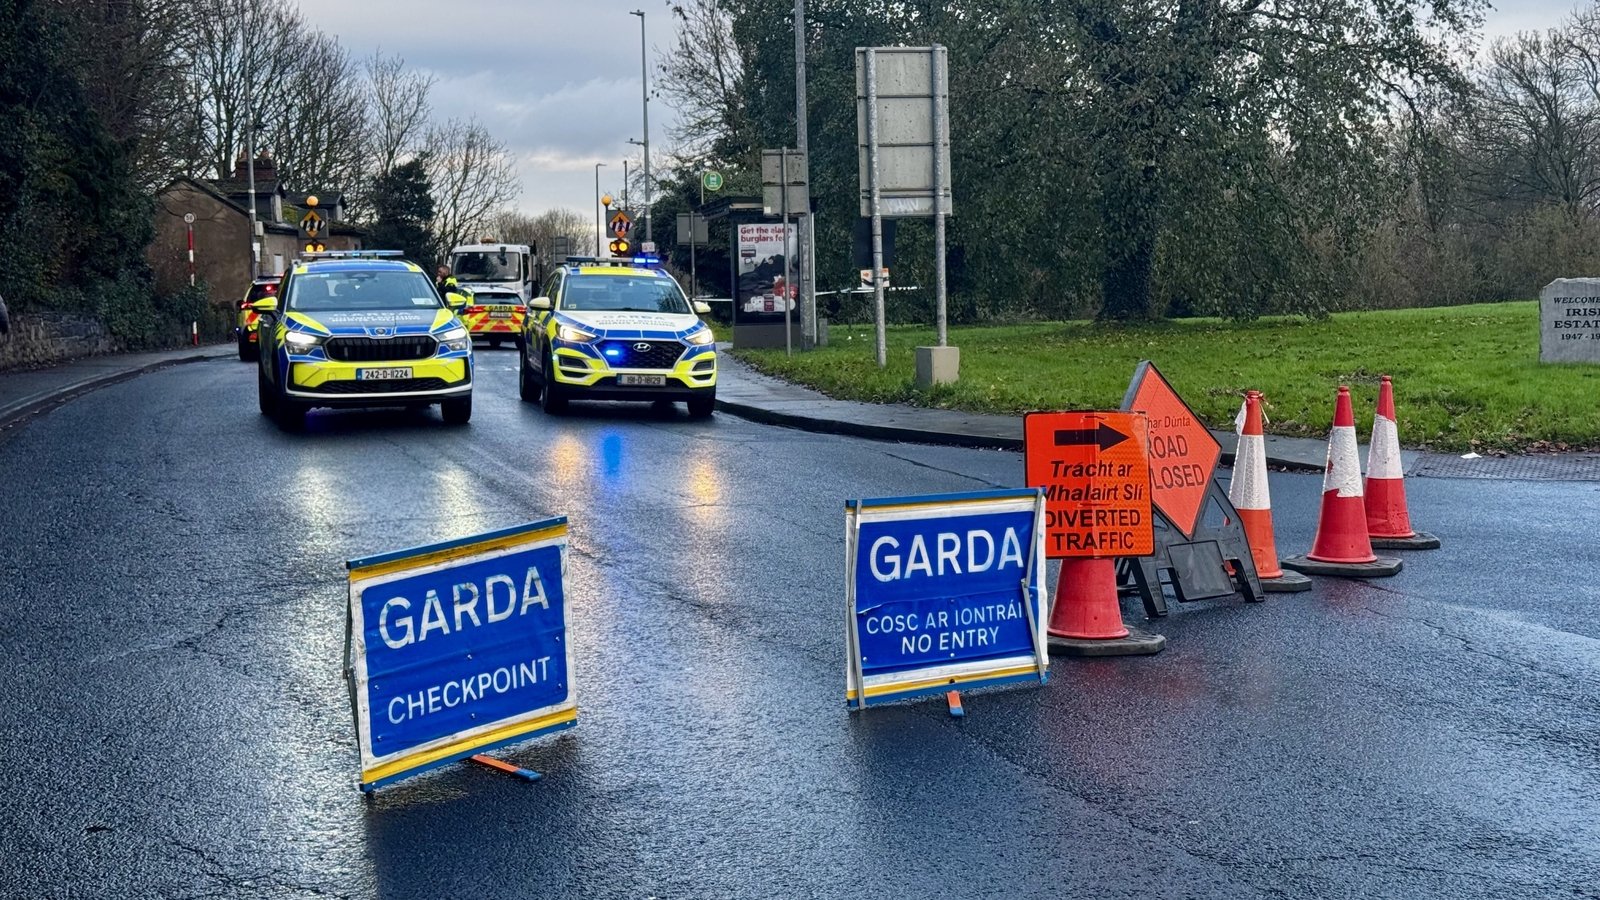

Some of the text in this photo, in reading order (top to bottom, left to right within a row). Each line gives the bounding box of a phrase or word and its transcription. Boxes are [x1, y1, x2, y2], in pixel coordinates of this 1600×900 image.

[740, 235, 773, 243] burglars
[756, 226, 769, 234] the
[770, 226, 793, 234] alam
[1554, 320, 1600, 328] ESTAT
[365, 370, 408, 379] 242-D-11224
[1164, 416, 1190, 428] Dúnta
[1051, 460, 1133, 478] Trácht ar
[1150, 463, 1205, 489] LOSED
[1046, 484, 1144, 502] Mhalairt Slí
[1046, 509, 1140, 528] DIVERTED
[1051, 531, 1134, 551] TRAFFIC
[869, 527, 1024, 583] GARDA
[379, 566, 550, 649] GARDA
[866, 599, 1025, 635] COSC AR IONTRÁI
[901, 626, 999, 654] NO ENTRY
[387, 656, 551, 725] CHECKPOINT
